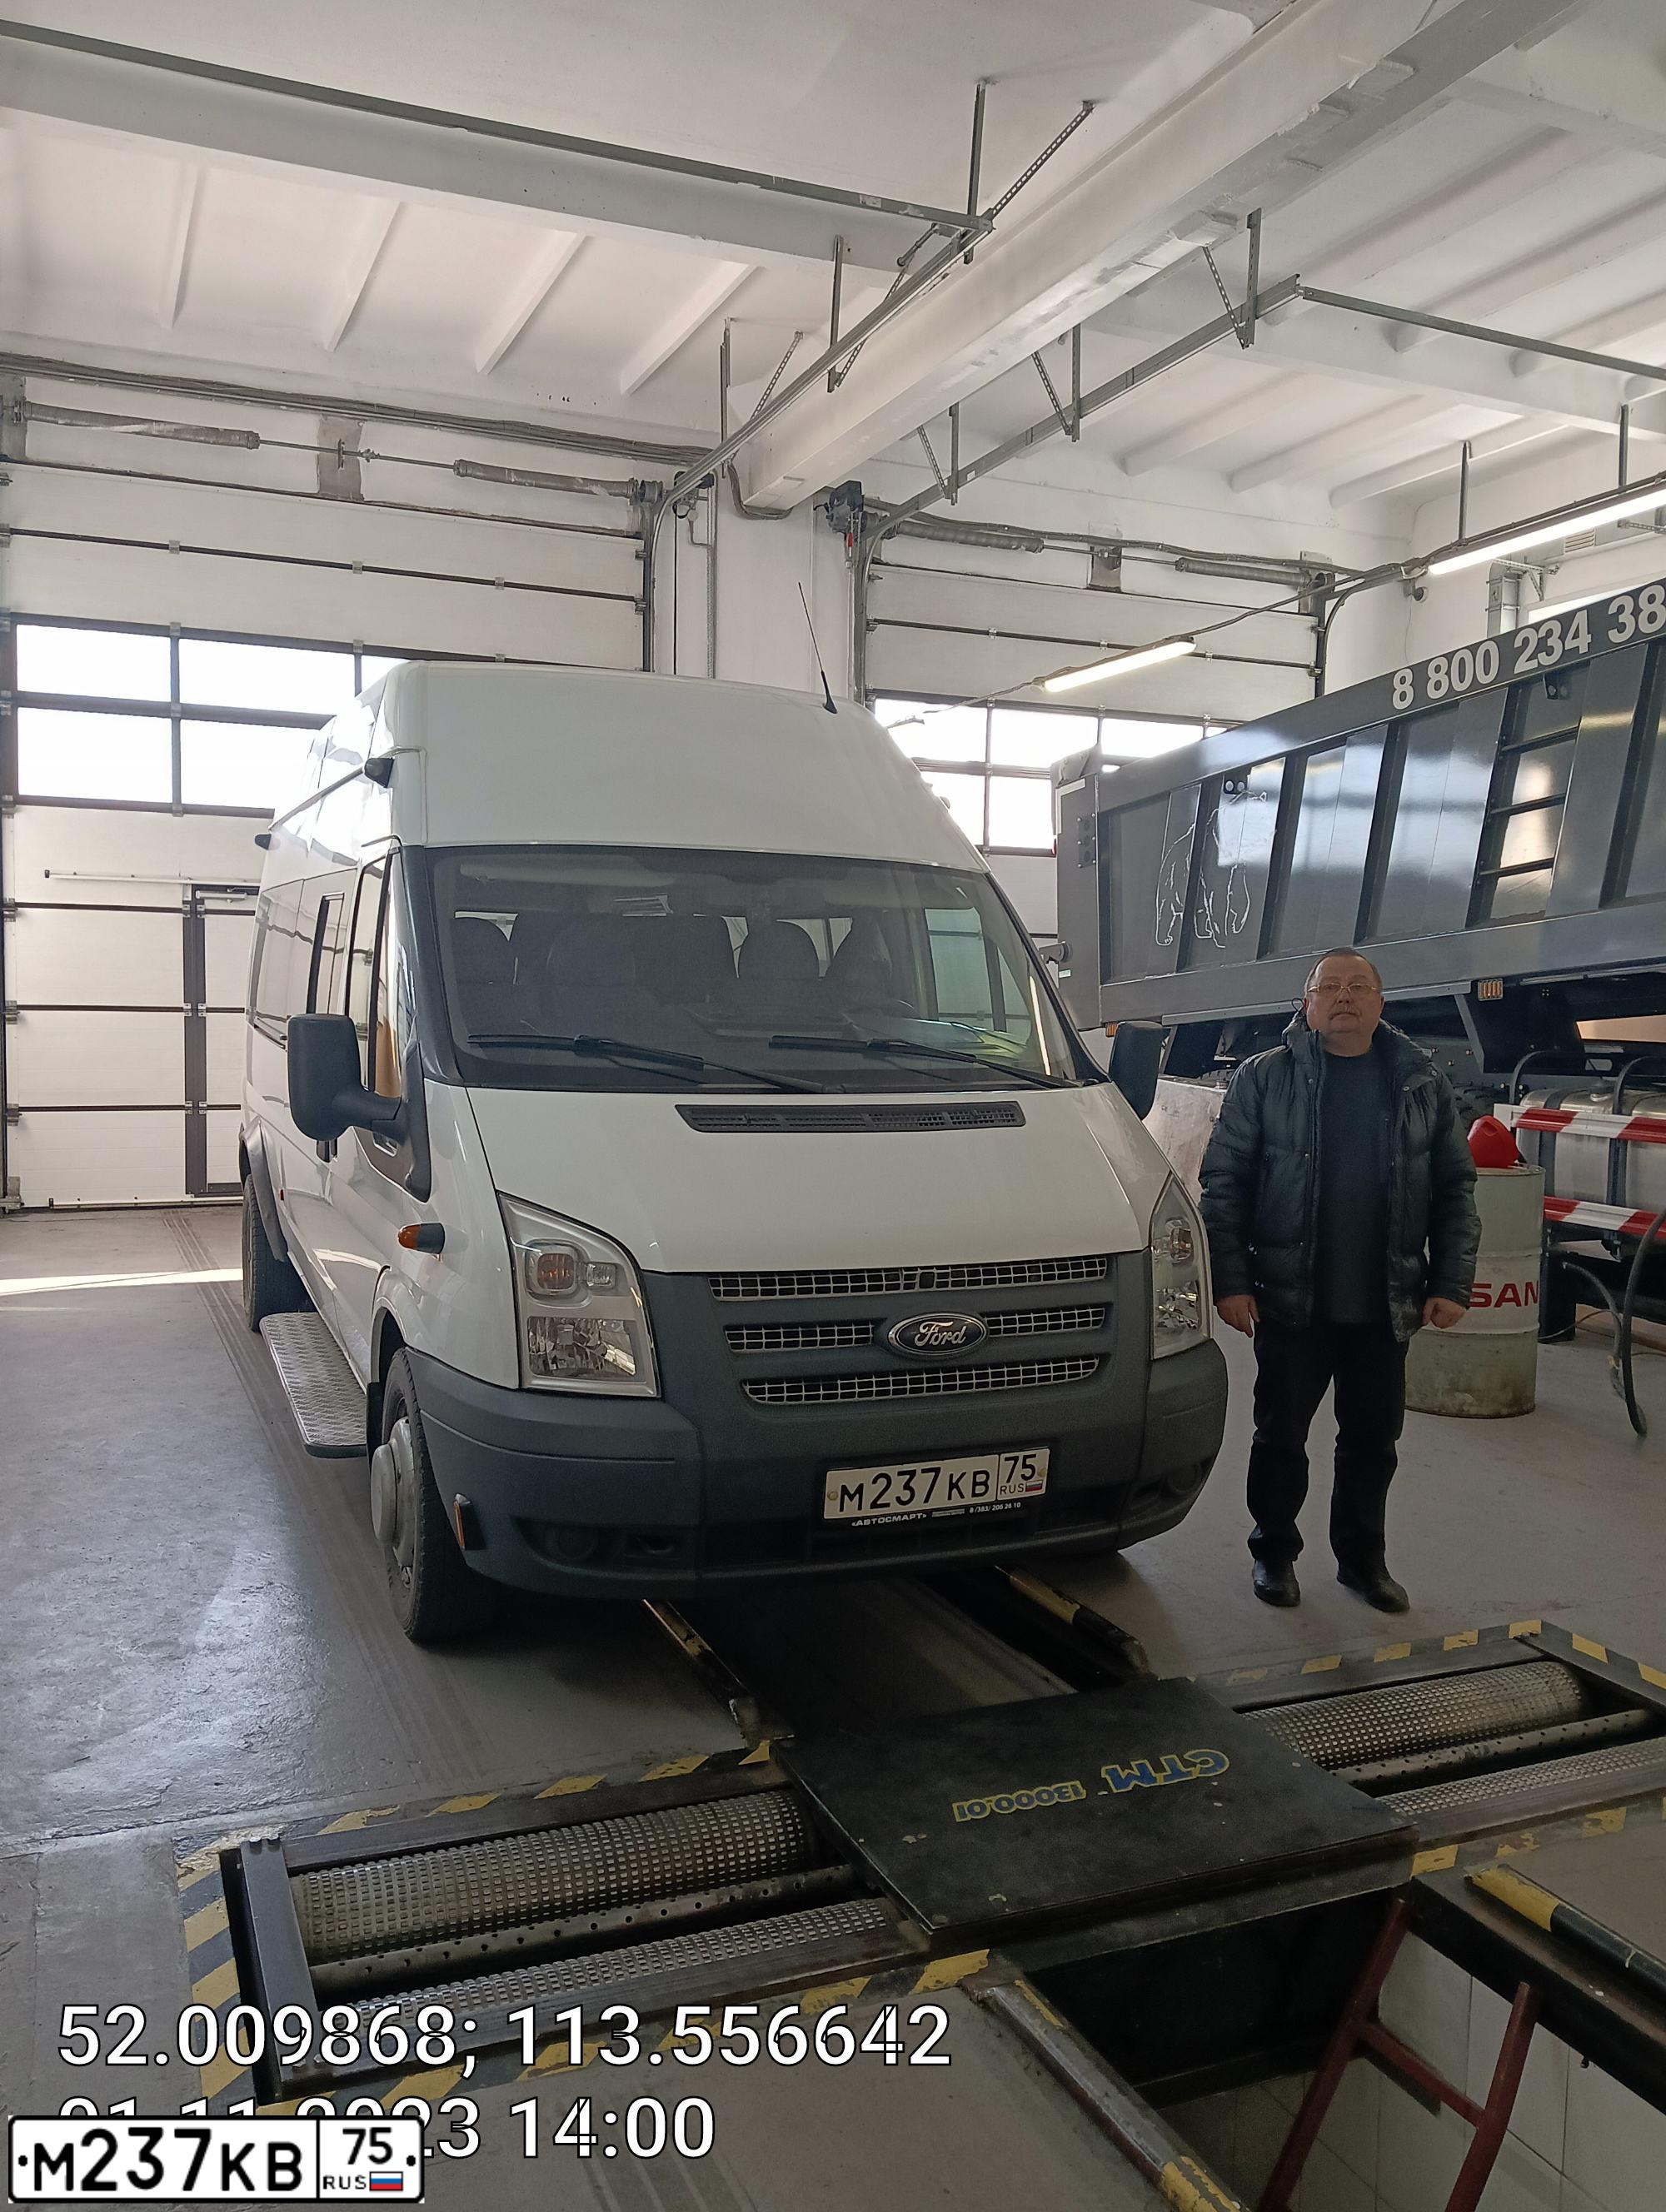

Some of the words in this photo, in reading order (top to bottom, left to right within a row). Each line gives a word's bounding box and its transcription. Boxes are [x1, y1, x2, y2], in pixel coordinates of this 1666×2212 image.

[1392, 668, 1414, 710] 8
[1426, 640, 1499, 700] 800
[1513, 609, 1592, 675] 234
[1607, 585, 1666, 644] 38
[914, 1321, 968, 1347] Ford
[1005, 1454, 1037, 1483] 75
[1000, 1483, 1025, 1496] RUS
